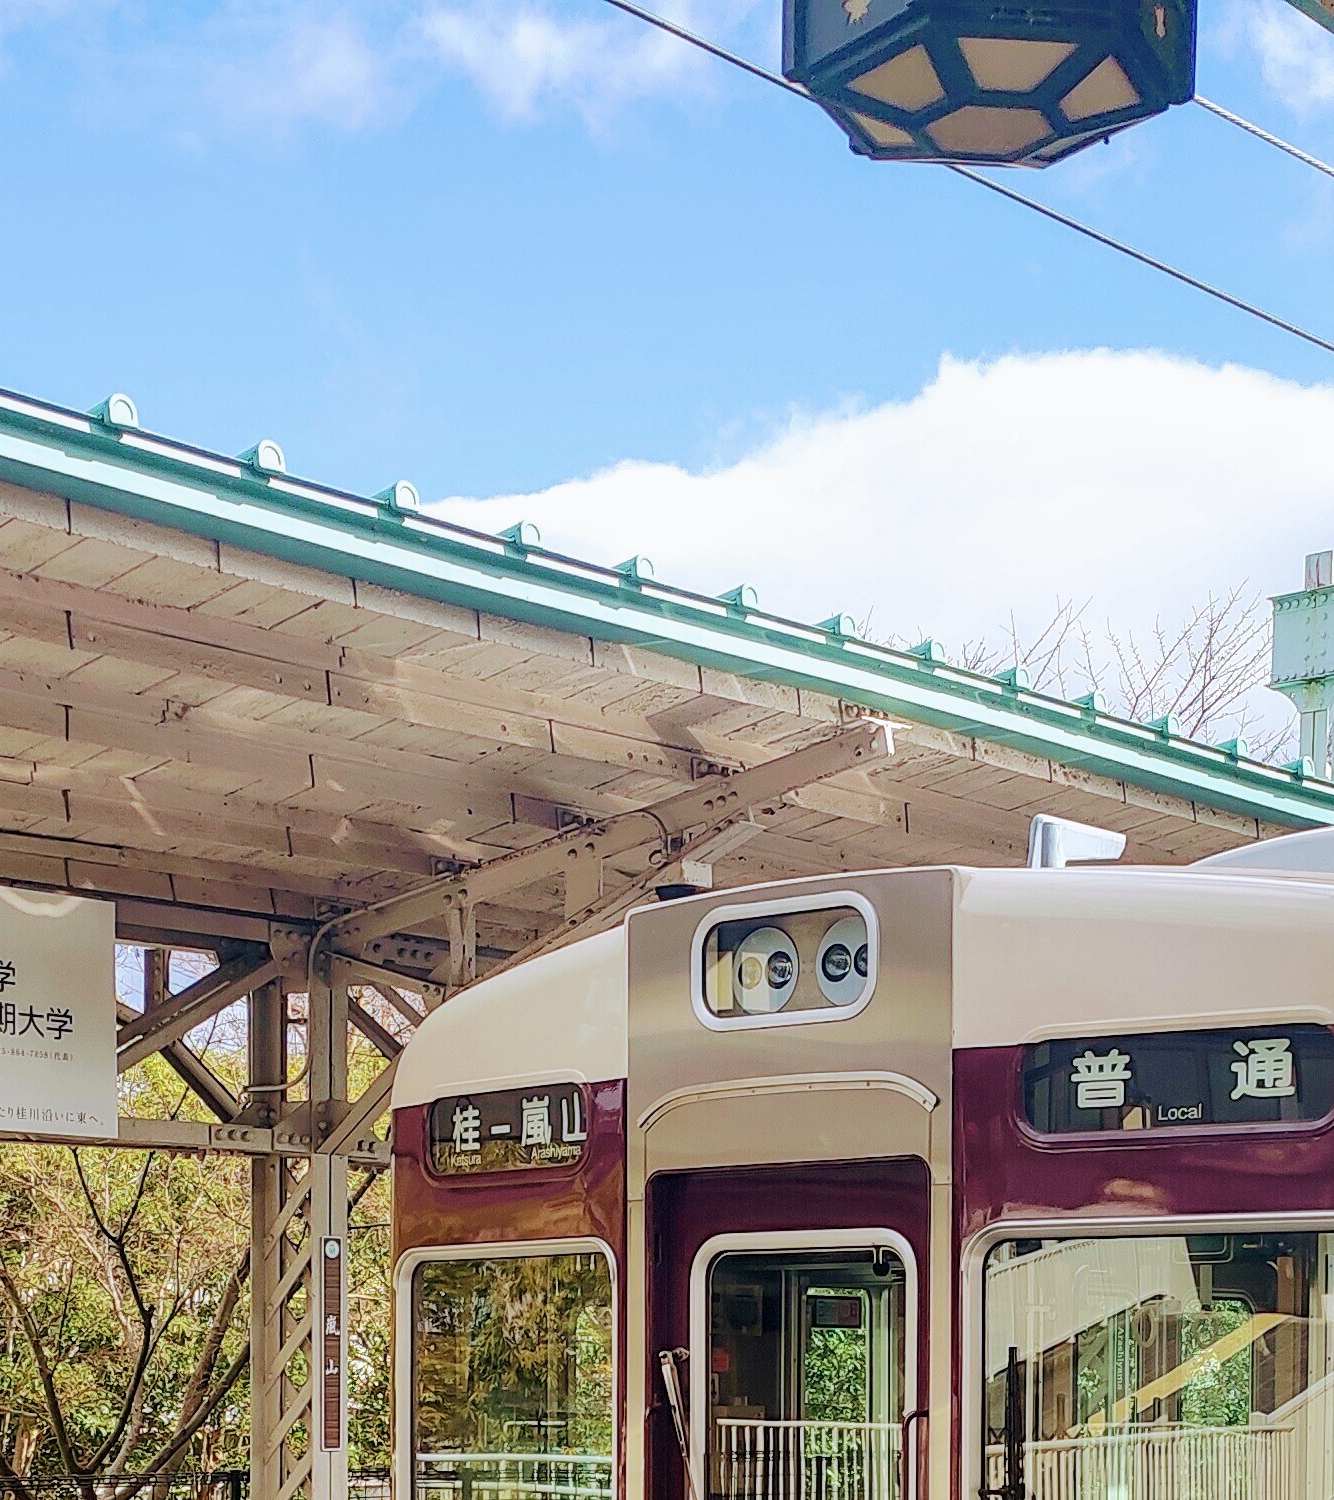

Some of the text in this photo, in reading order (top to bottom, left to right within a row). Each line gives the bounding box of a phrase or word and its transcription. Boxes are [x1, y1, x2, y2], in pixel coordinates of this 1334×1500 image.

[1070, 1038, 1296, 1109] 普通
[1157, 1103, 1203, 1121] Local
[450, 1144, 581, 1168] Katsura Arashiyama
[325, 1315, 341, 1376] 嵐山
